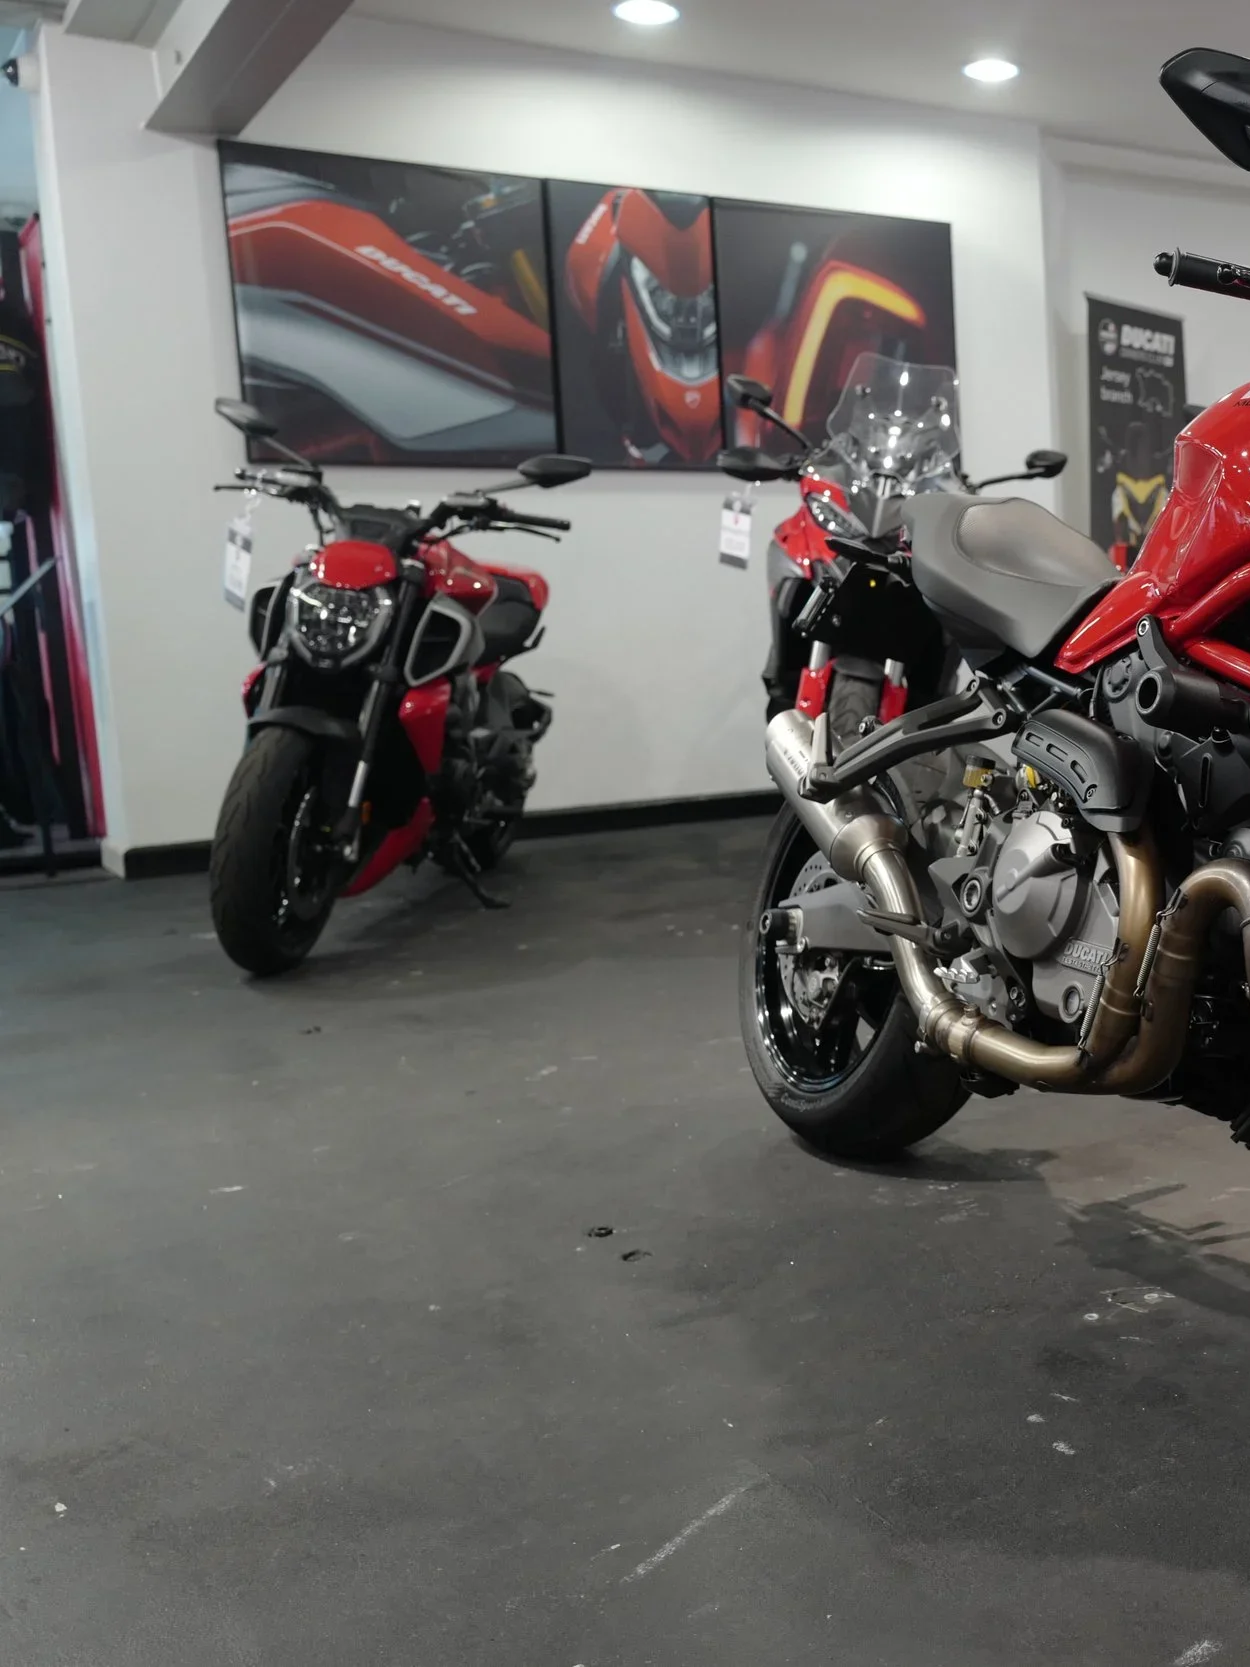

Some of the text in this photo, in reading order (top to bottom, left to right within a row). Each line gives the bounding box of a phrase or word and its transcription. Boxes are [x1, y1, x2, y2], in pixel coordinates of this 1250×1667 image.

[355, 245, 477, 315] DUCATI
[1120, 324, 1175, 355] DUCATI
[1063, 942, 1109, 966] DUCATI
